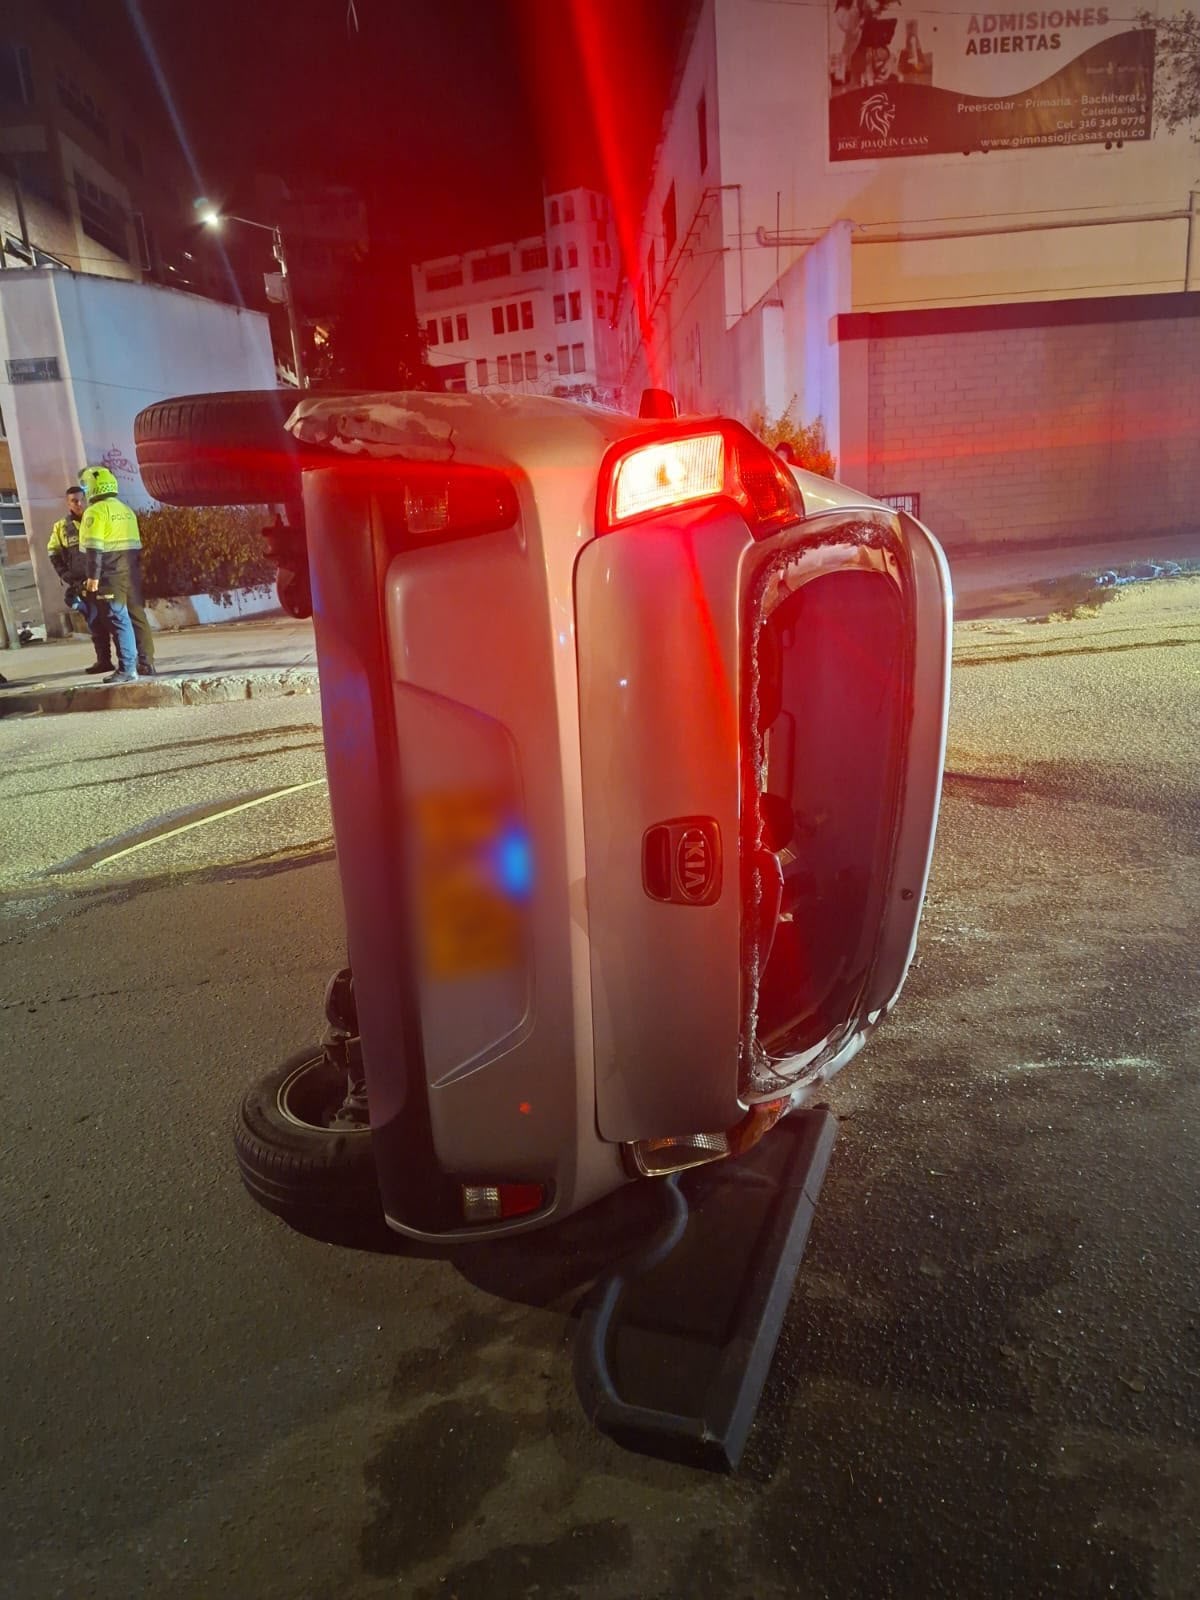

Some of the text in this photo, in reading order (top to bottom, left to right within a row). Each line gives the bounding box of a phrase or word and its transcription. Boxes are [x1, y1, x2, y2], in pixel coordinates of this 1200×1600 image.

[967, 7, 1109, 34] ADMISIONES
[966, 33, 1061, 55] ABIERTAS
[957, 101, 1015, 113] Preescolar
[1025, 97, 1072, 109] Primaria
[1080, 118, 1097, 129] 316
[1100, 116, 1118, 128] 348
[900, 136, 929, 146] CASAS
[685, 841, 705, 888] KIA
